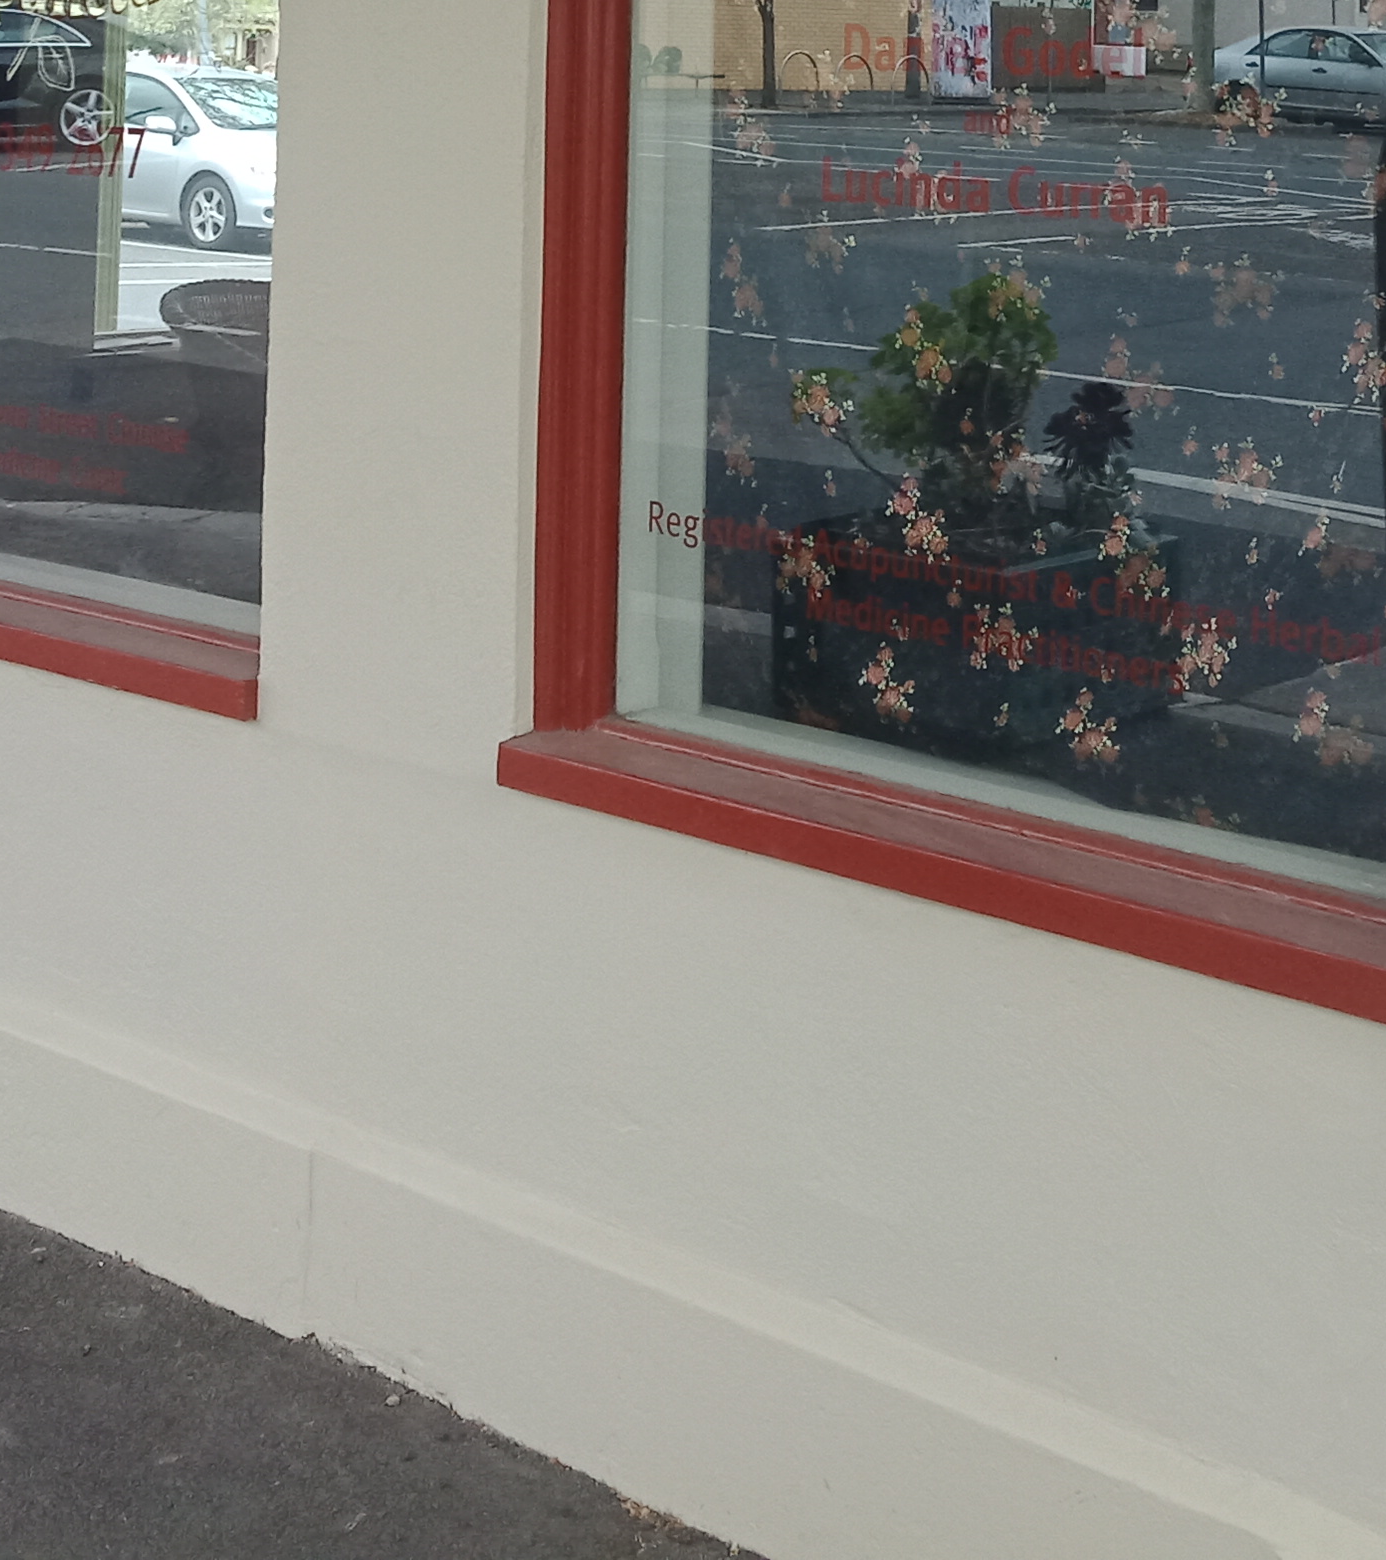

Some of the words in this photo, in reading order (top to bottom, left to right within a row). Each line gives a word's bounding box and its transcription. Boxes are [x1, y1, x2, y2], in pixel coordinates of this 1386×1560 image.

[844, 23, 984, 76] Daniel
[1002, 25, 1146, 80] Godel
[963, 107, 1013, 136] and
[820, 156, 991, 213] Lucinda
[1008, 164, 1170, 227] Curran
[647, 500, 802, 557] Registered
[813, 527, 1038, 603] Acupuncturist
[1052, 570, 1078, 609] &
[1090, 577, 1237, 640] Chinese
[1250, 605, 1384, 667] Herbal
[805, 584, 951, 643] Medicine
[962, 613, 1186, 695] Practitioners
